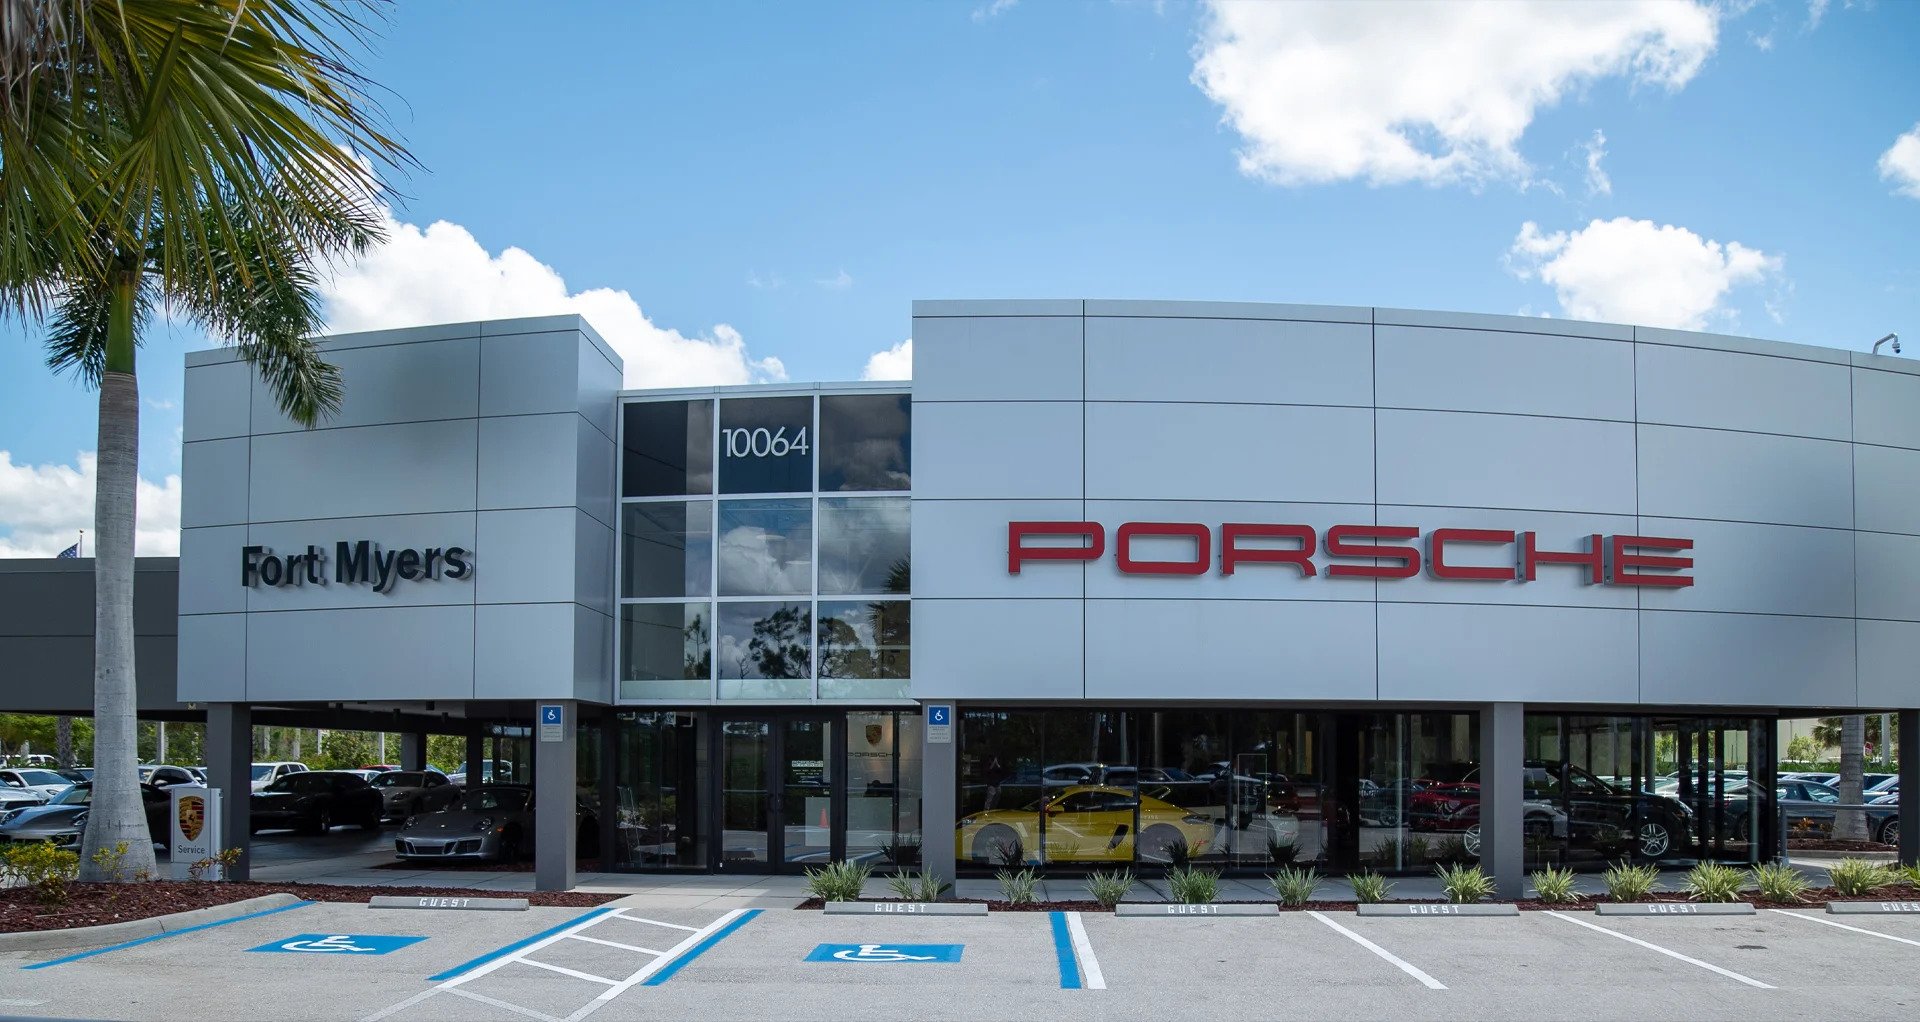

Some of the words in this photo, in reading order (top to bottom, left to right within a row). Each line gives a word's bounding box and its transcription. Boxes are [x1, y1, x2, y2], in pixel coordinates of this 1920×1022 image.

[722, 426, 809, 458] 10064
[1008, 521, 1694, 587] PORSCHE
[242, 544, 323, 587] Fort
[336, 540, 472, 594] Myers
[178, 845, 205, 854] Service
[419, 898, 470, 908] GUEST
[874, 903, 926, 913] GUEST
[1167, 904, 1219, 914] GUEST
[1408, 904, 1459, 914] GUEST
[1648, 904, 1698, 913] GUEST
